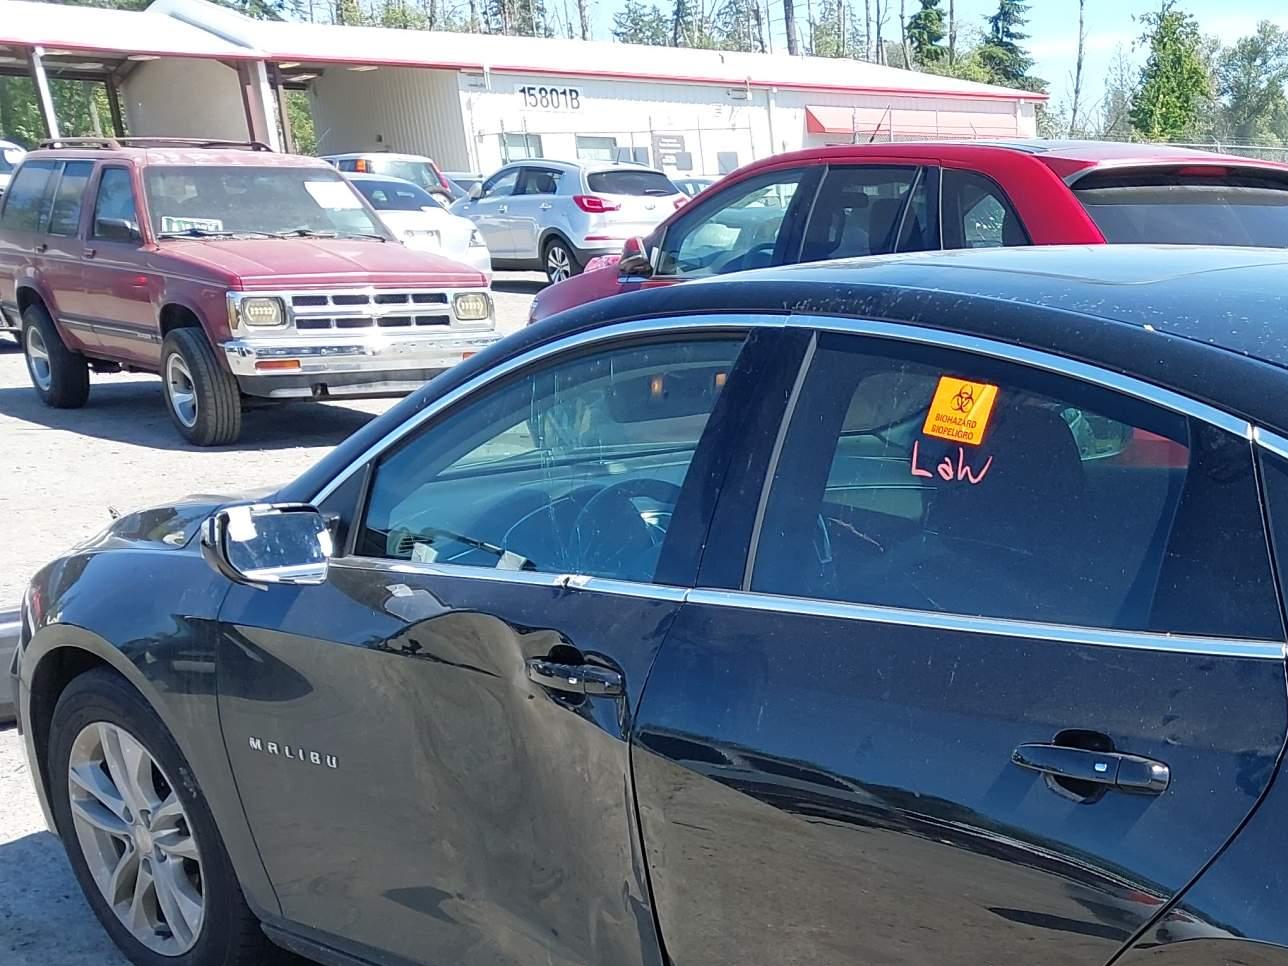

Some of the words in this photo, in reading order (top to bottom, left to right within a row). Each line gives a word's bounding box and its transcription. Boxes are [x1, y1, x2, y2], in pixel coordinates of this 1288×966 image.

[518, 86, 581, 110] 15801B
[934, 413, 978, 429] BIOHAZARD
[930, 424, 975, 441] BIOPELIGRO
[248, 736, 338, 769] MALIBU
